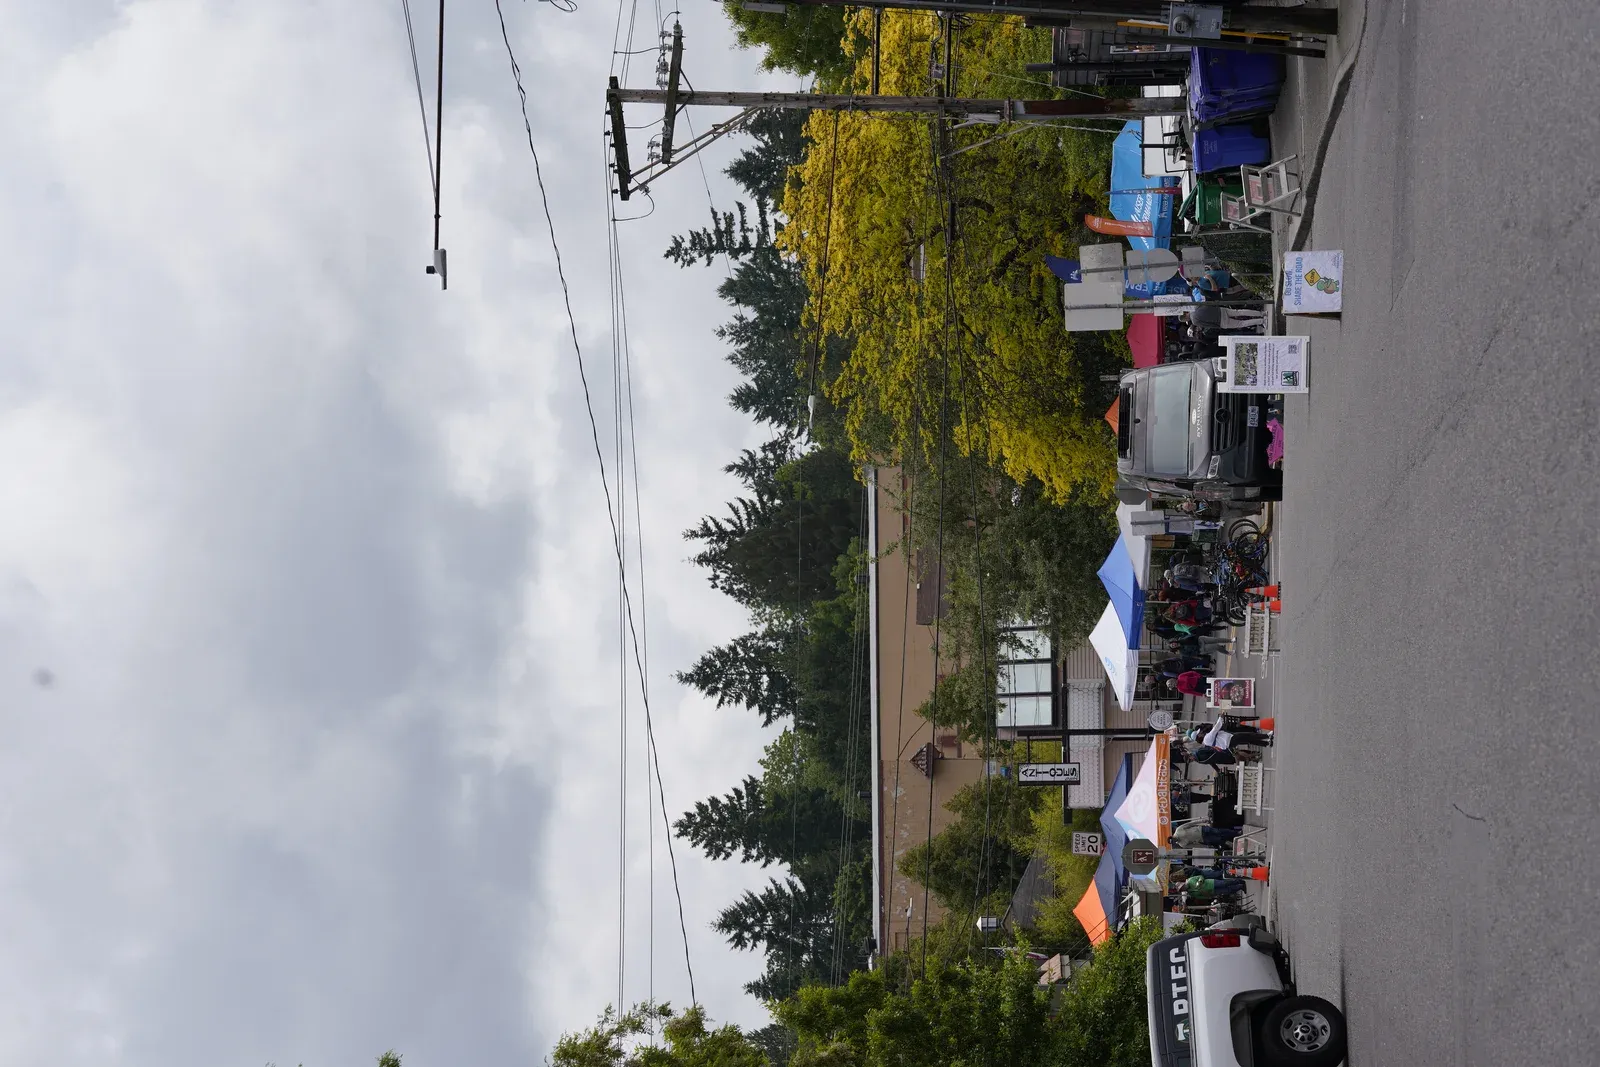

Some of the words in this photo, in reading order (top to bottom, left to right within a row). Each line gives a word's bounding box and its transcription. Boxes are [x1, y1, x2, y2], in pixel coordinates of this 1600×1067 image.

[1284, 288, 1292, 296] GO
[1294, 287, 1302, 305] SHARE
[1022, 768, 1076, 778] ANTIQUES
[1087, 835, 1098, 853] 20
